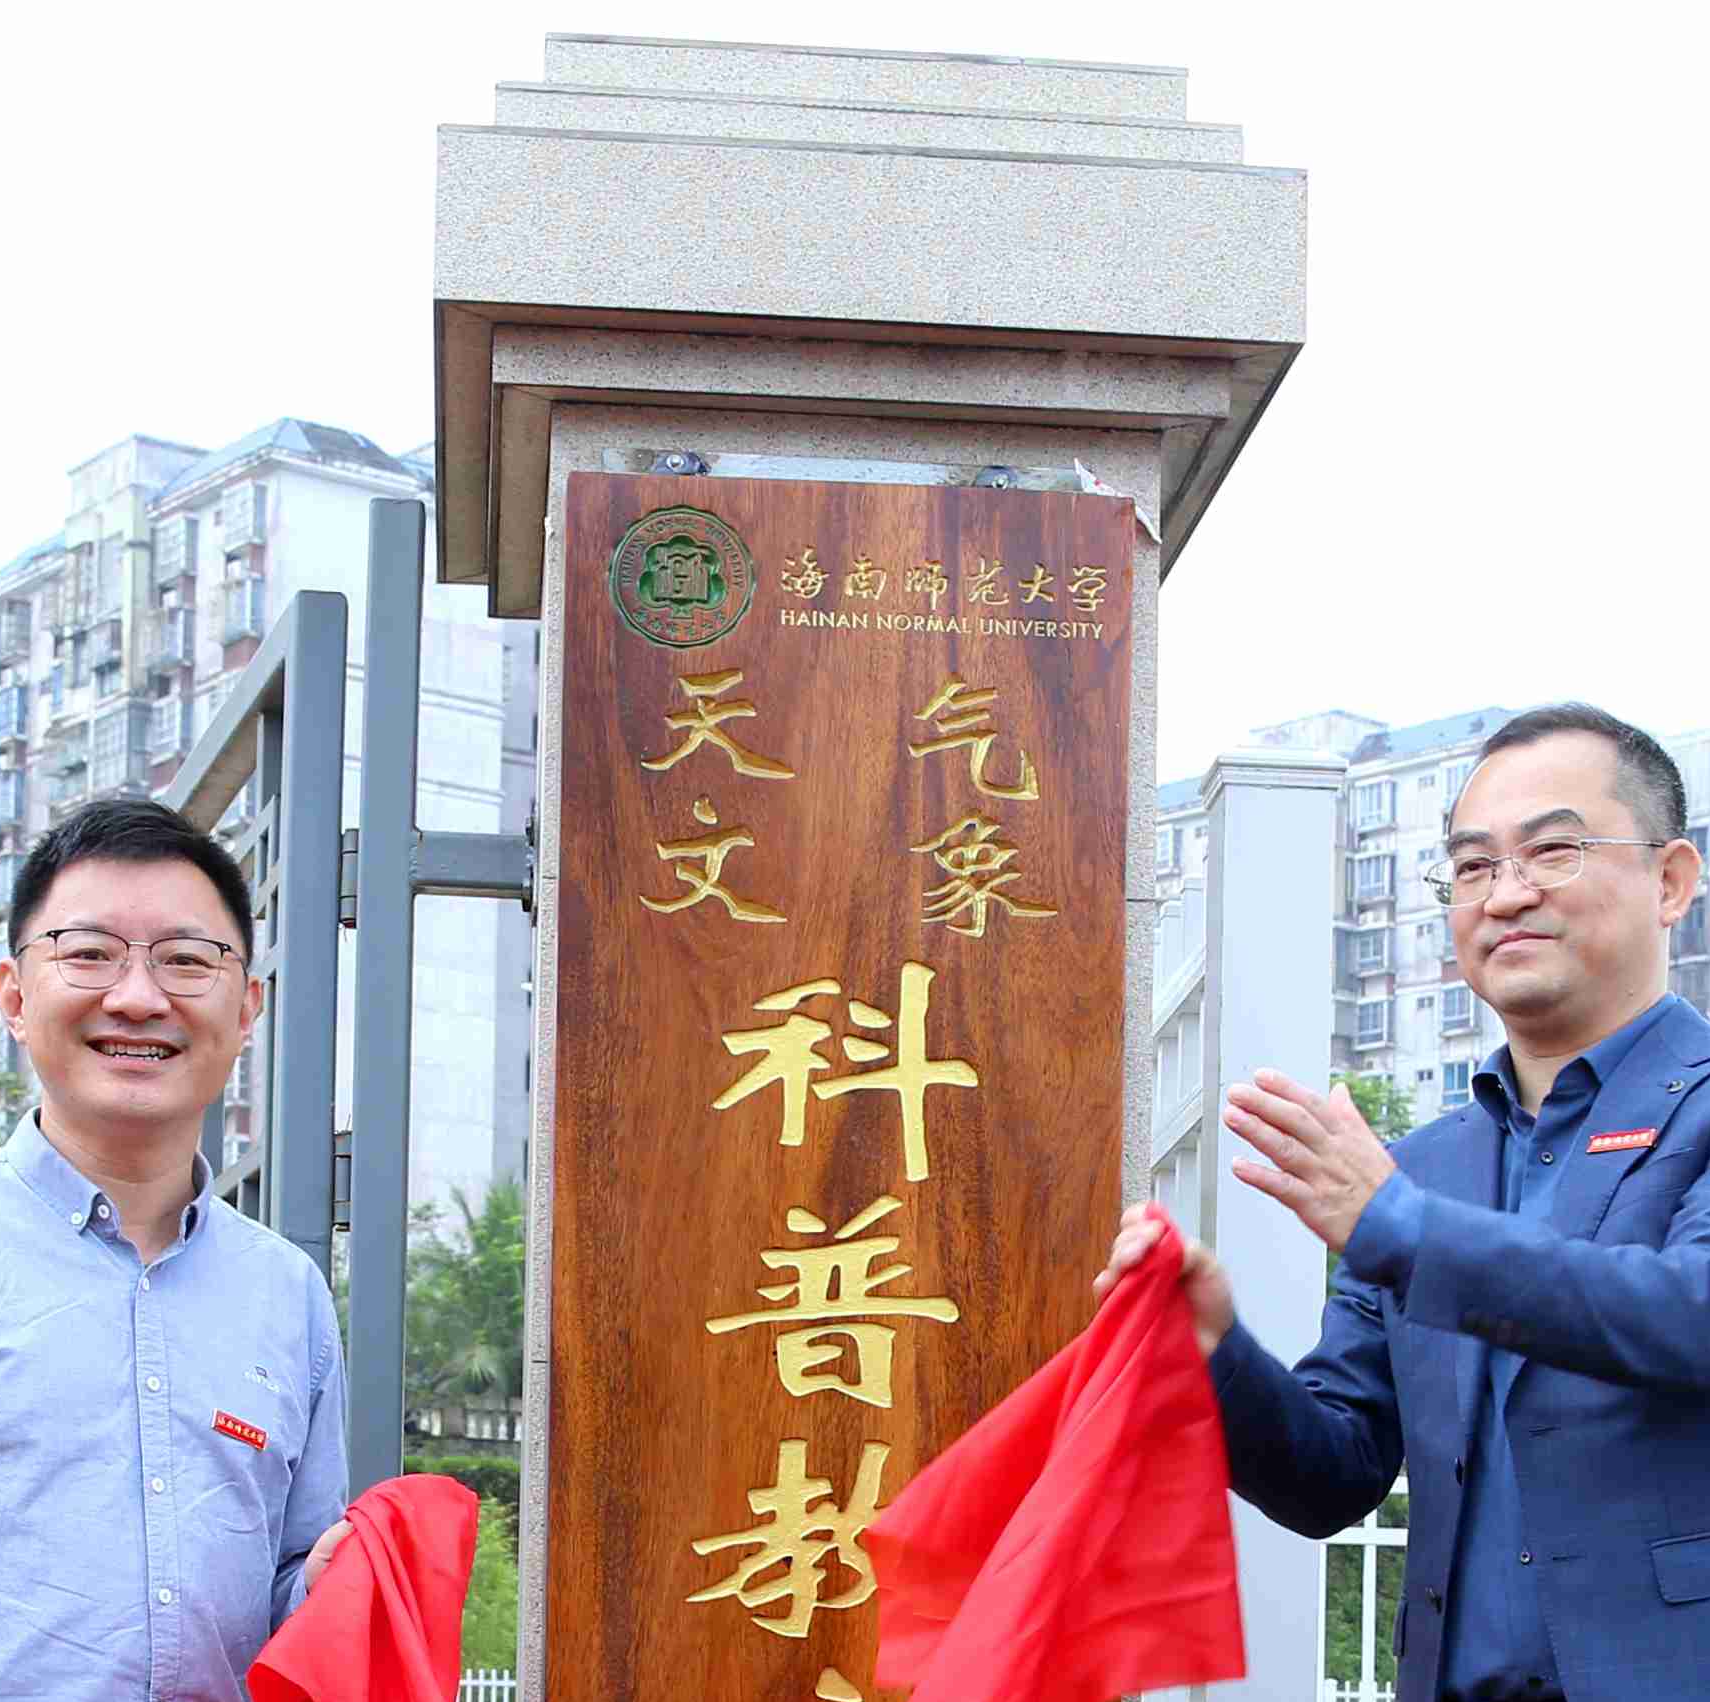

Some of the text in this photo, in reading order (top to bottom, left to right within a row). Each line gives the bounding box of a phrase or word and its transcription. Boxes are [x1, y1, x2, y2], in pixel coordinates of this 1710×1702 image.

[780, 608, 1105, 640] HAINAN NORMAL UNIVERSITY
[640, 668, 796, 924] 天文
[907, 673, 1059, 938] 气象
